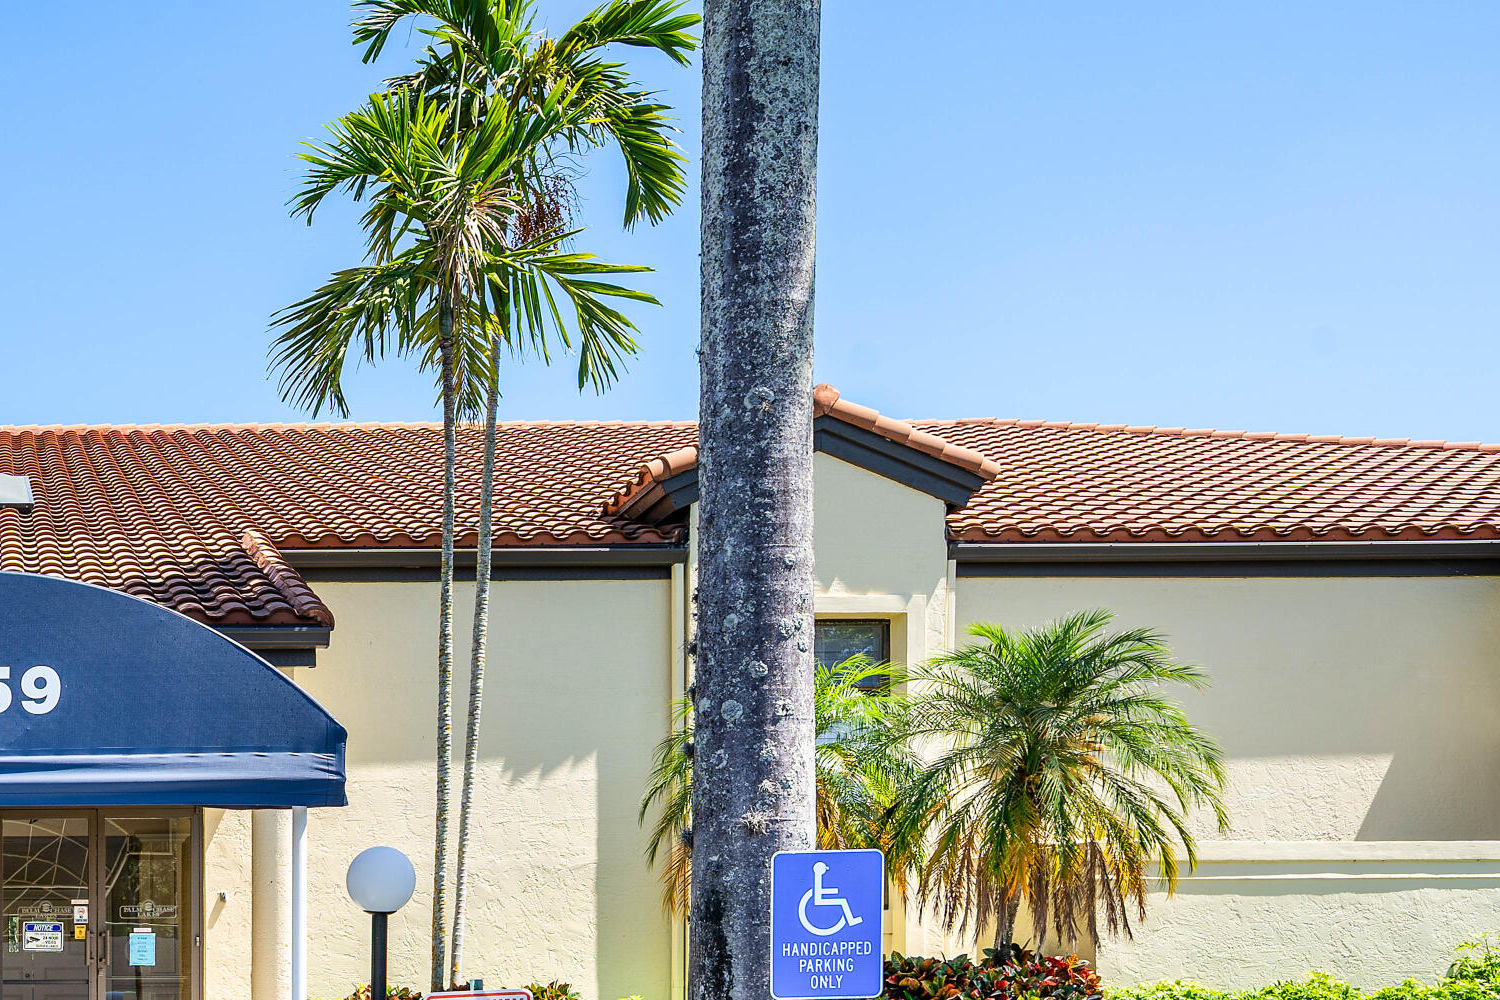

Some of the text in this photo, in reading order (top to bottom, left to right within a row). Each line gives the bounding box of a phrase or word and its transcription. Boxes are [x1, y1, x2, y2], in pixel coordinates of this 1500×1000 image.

[782, 941, 872, 957] HANDICAPPED
[799, 958, 854, 973] PARKING
[810, 974, 844, 989] ONLY
